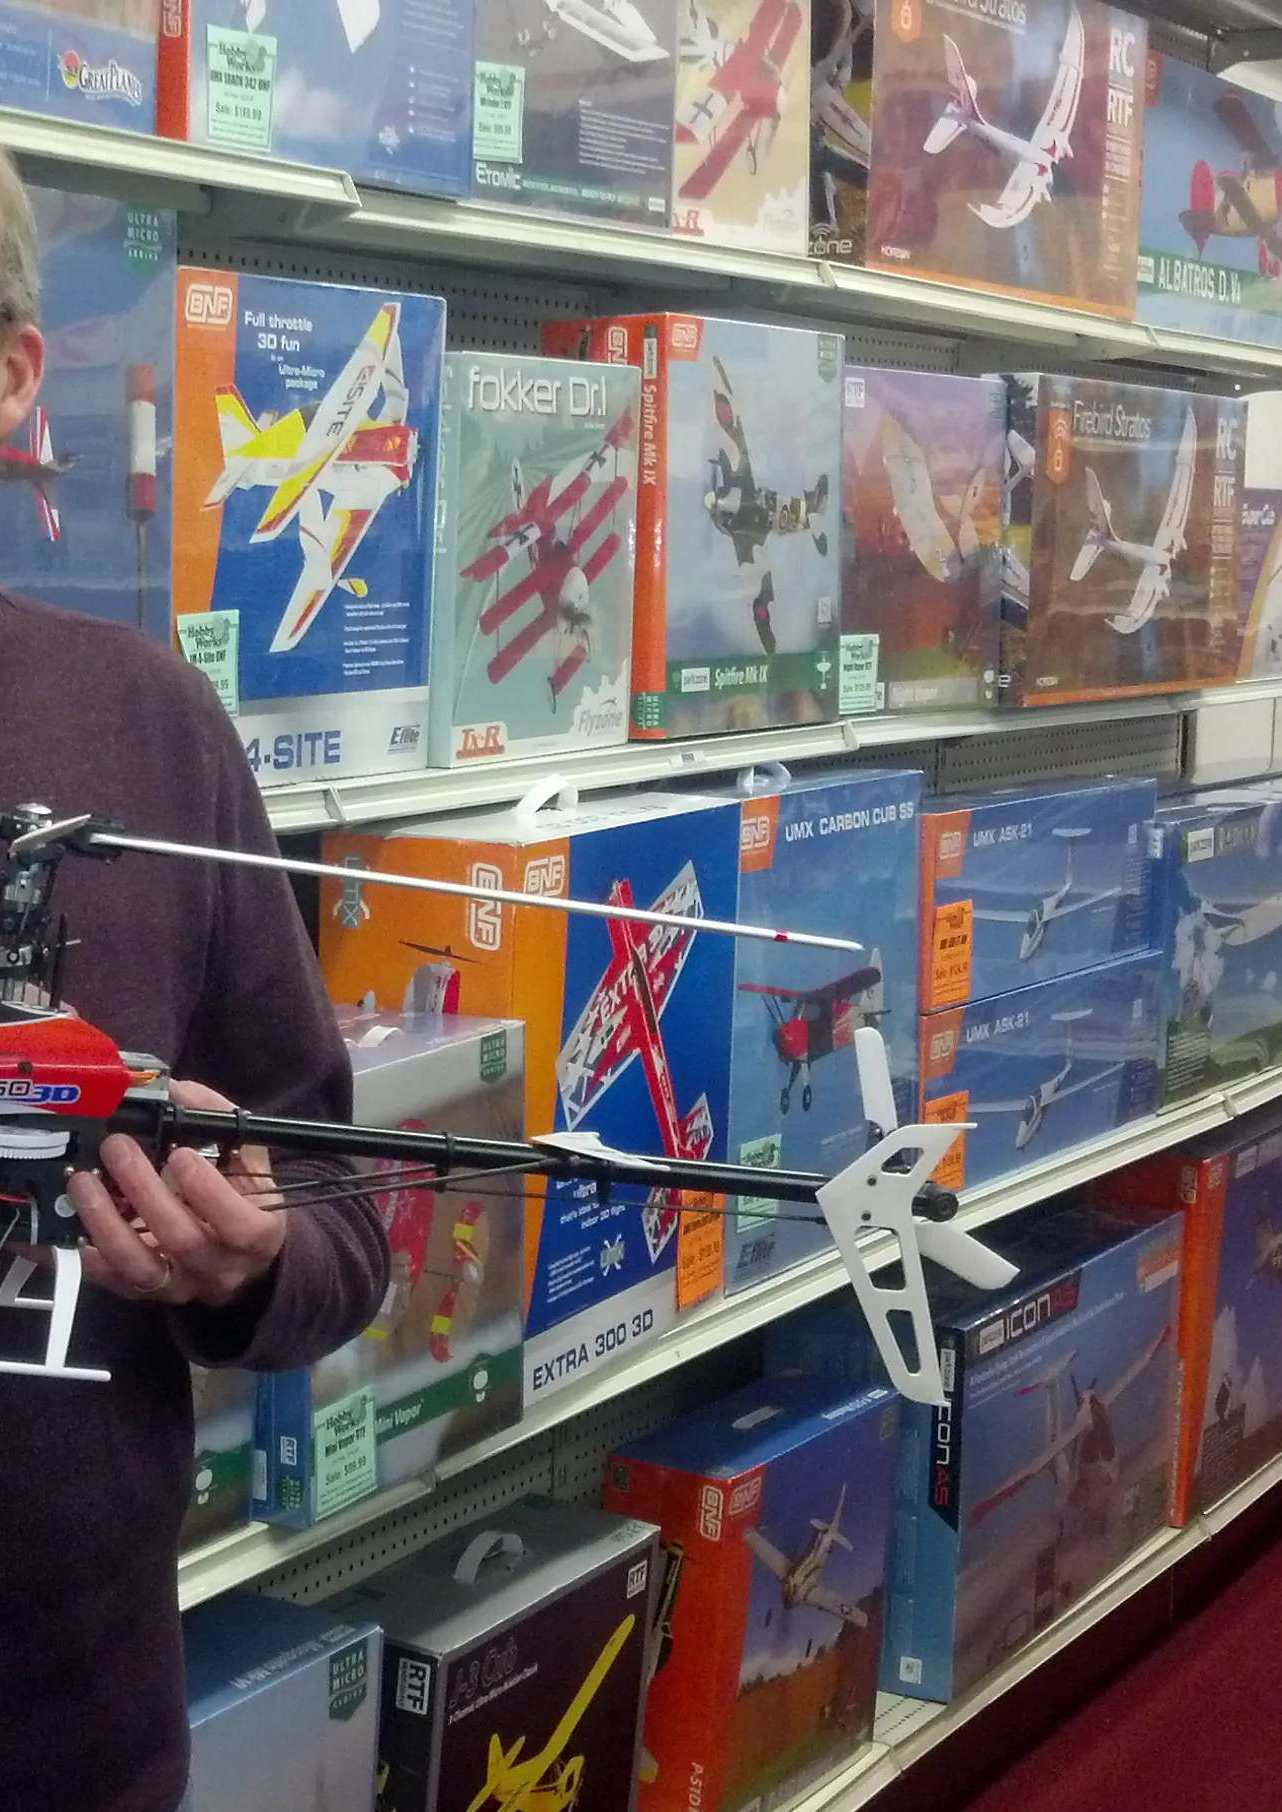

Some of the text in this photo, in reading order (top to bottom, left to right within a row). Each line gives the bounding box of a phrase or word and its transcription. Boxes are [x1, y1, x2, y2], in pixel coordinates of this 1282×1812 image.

[244, 311, 313, 332] Full throttle
[257, 333, 301, 352] 3D fun
[467, 366, 562, 414] fokker
[714, 665, 744, 690] Spitfire
[578, 700, 622, 737] Flyzone
[785, 822, 814, 842] UMX
[819, 810, 870, 835] CARBON
[872, 805, 896, 825] CUB
[973, 831, 995, 848] UMX
[967, 1026, 989, 1043] UMX
[533, 1308, 654, 1391] EXTRA 300 3D
[332, 1650, 365, 1674] ULTRA
[332, 1664, 365, 1690] MICRO
[409, 1662, 429, 1714] RTF
